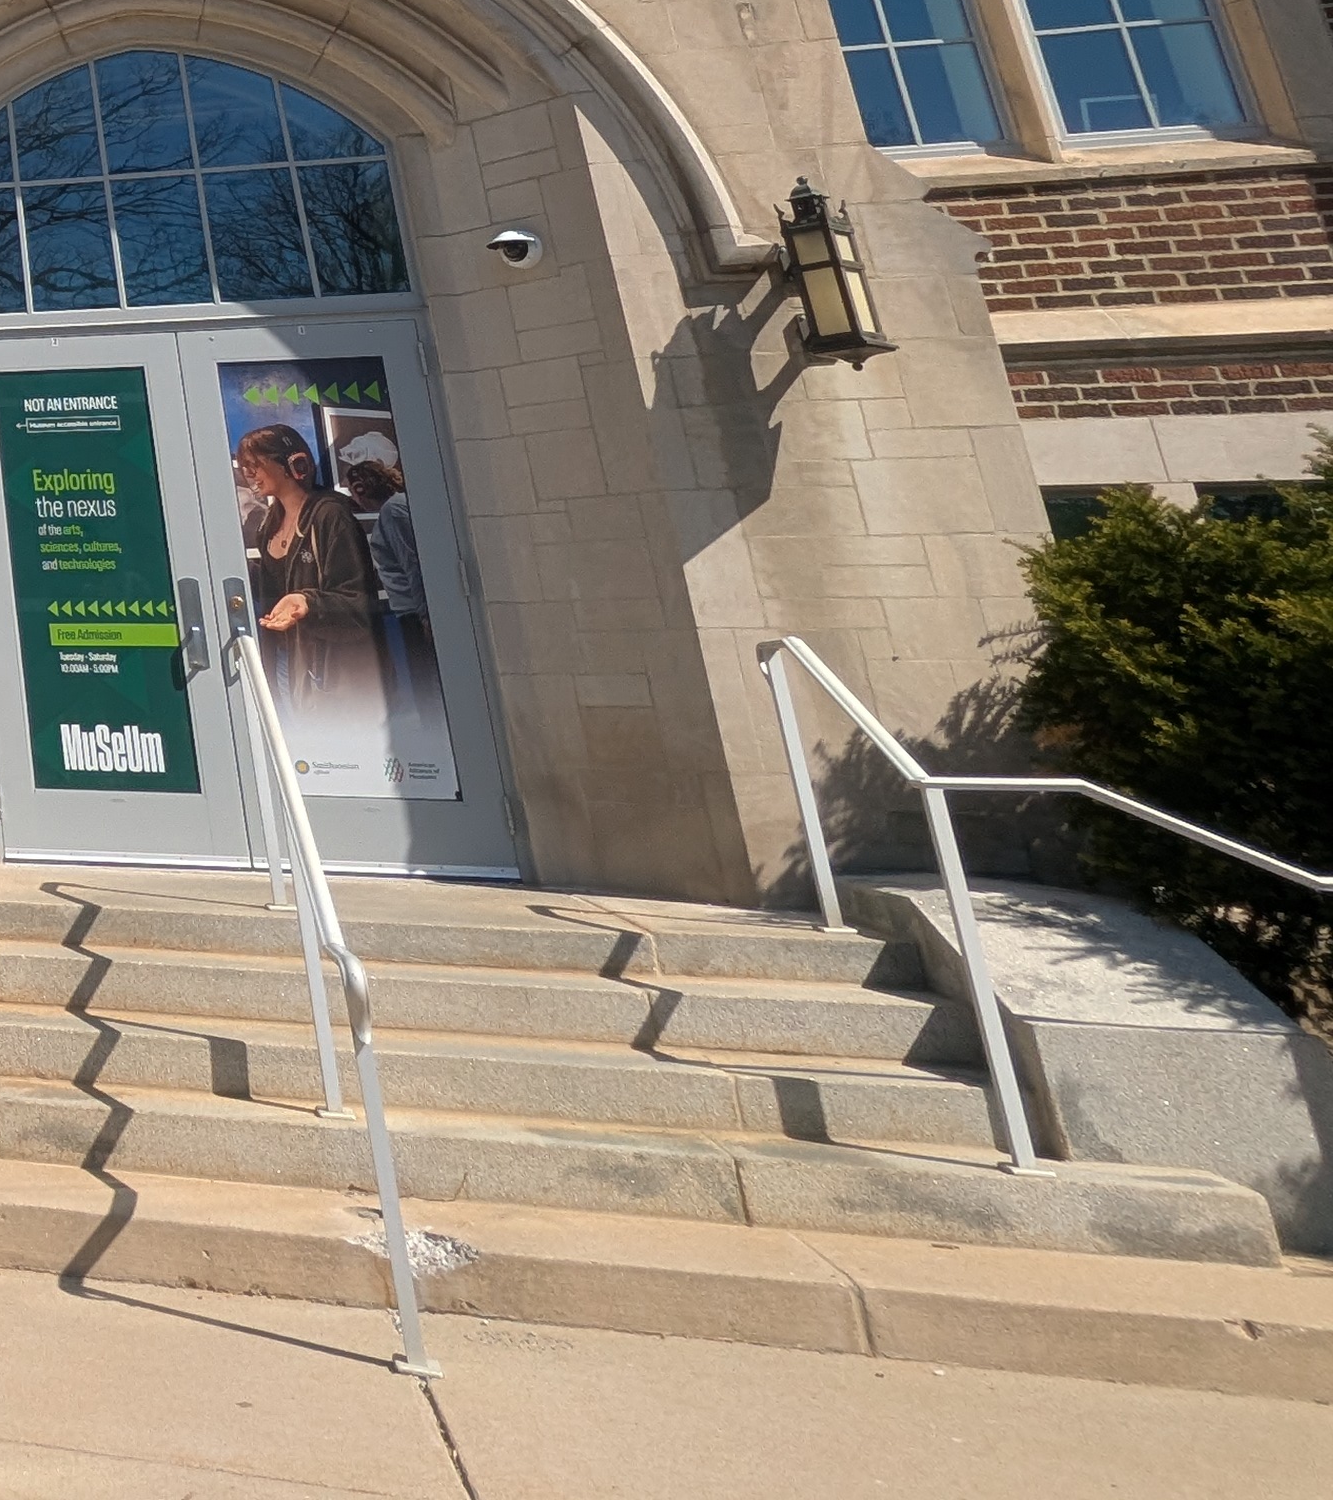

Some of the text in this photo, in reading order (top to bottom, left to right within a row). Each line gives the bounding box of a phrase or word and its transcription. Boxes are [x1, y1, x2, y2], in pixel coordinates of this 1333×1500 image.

[23, 396, 118, 412] NOT AN ENTRANCE
[32, 468, 115, 496] Exploring
[35, 495, 117, 518] the nexus
[38, 524, 83, 537] of the arts,
[40, 541, 122, 554] sciences, cultures,
[41, 558, 116, 572] and technologies
[57, 629, 123, 640] Free Admission
[88, 651, 117, 662] Saturday
[59, 723, 166, 773] MuSeUm
